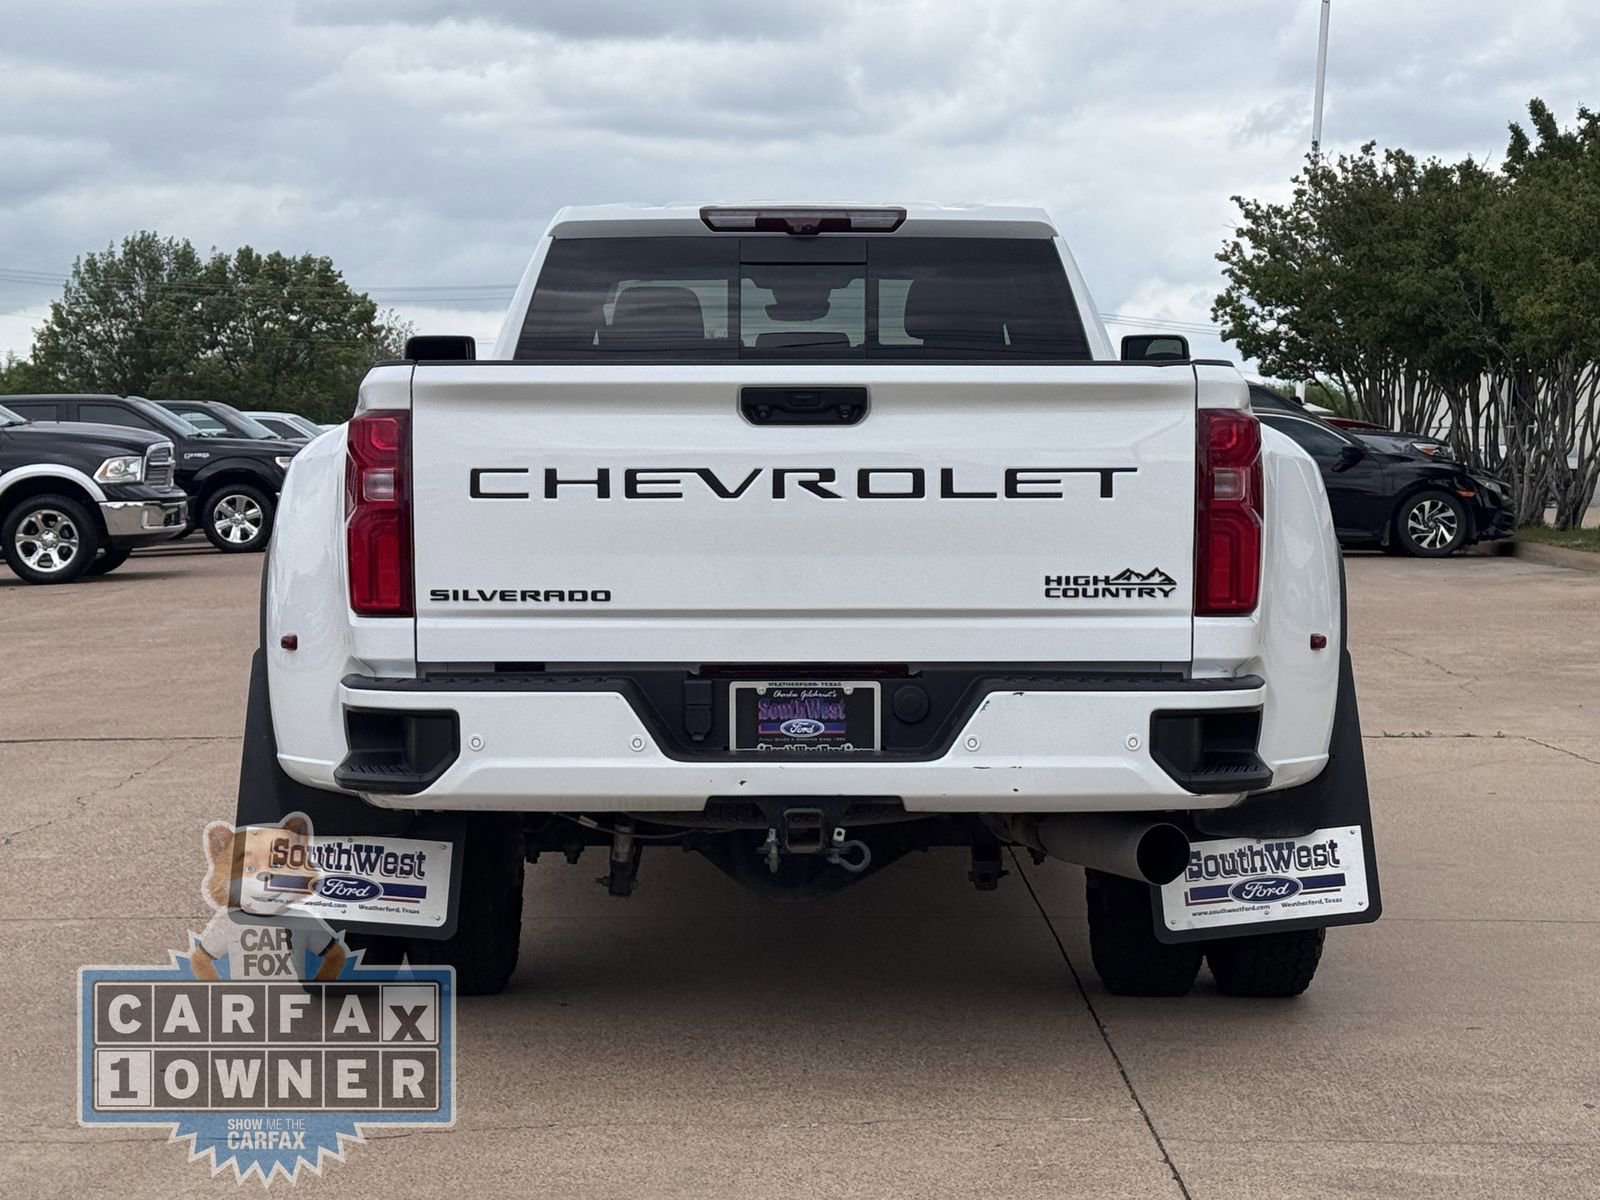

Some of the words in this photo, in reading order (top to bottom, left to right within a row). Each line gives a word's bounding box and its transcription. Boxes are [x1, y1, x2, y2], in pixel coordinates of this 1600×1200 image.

[469, 467, 1138, 499] CHEVROLET
[1044, 575, 1110, 586] HIGH
[430, 589, 611, 602] SILVERADO
[1044, 587, 1176, 599] COUNTRY
[758, 698, 846, 720] SouthWest
[790, 722, 815, 734] Ford
[270, 837, 426, 880] SouthWest
[1185, 839, 1341, 882] SouthWest
[321, 877, 371, 898] Ford
[1242, 880, 1290, 899] Ford
[402, 907, 420, 915] Texas
[1281, 898, 1324, 909] Weatherford,
[1325, 897, 1343, 905] Texas
